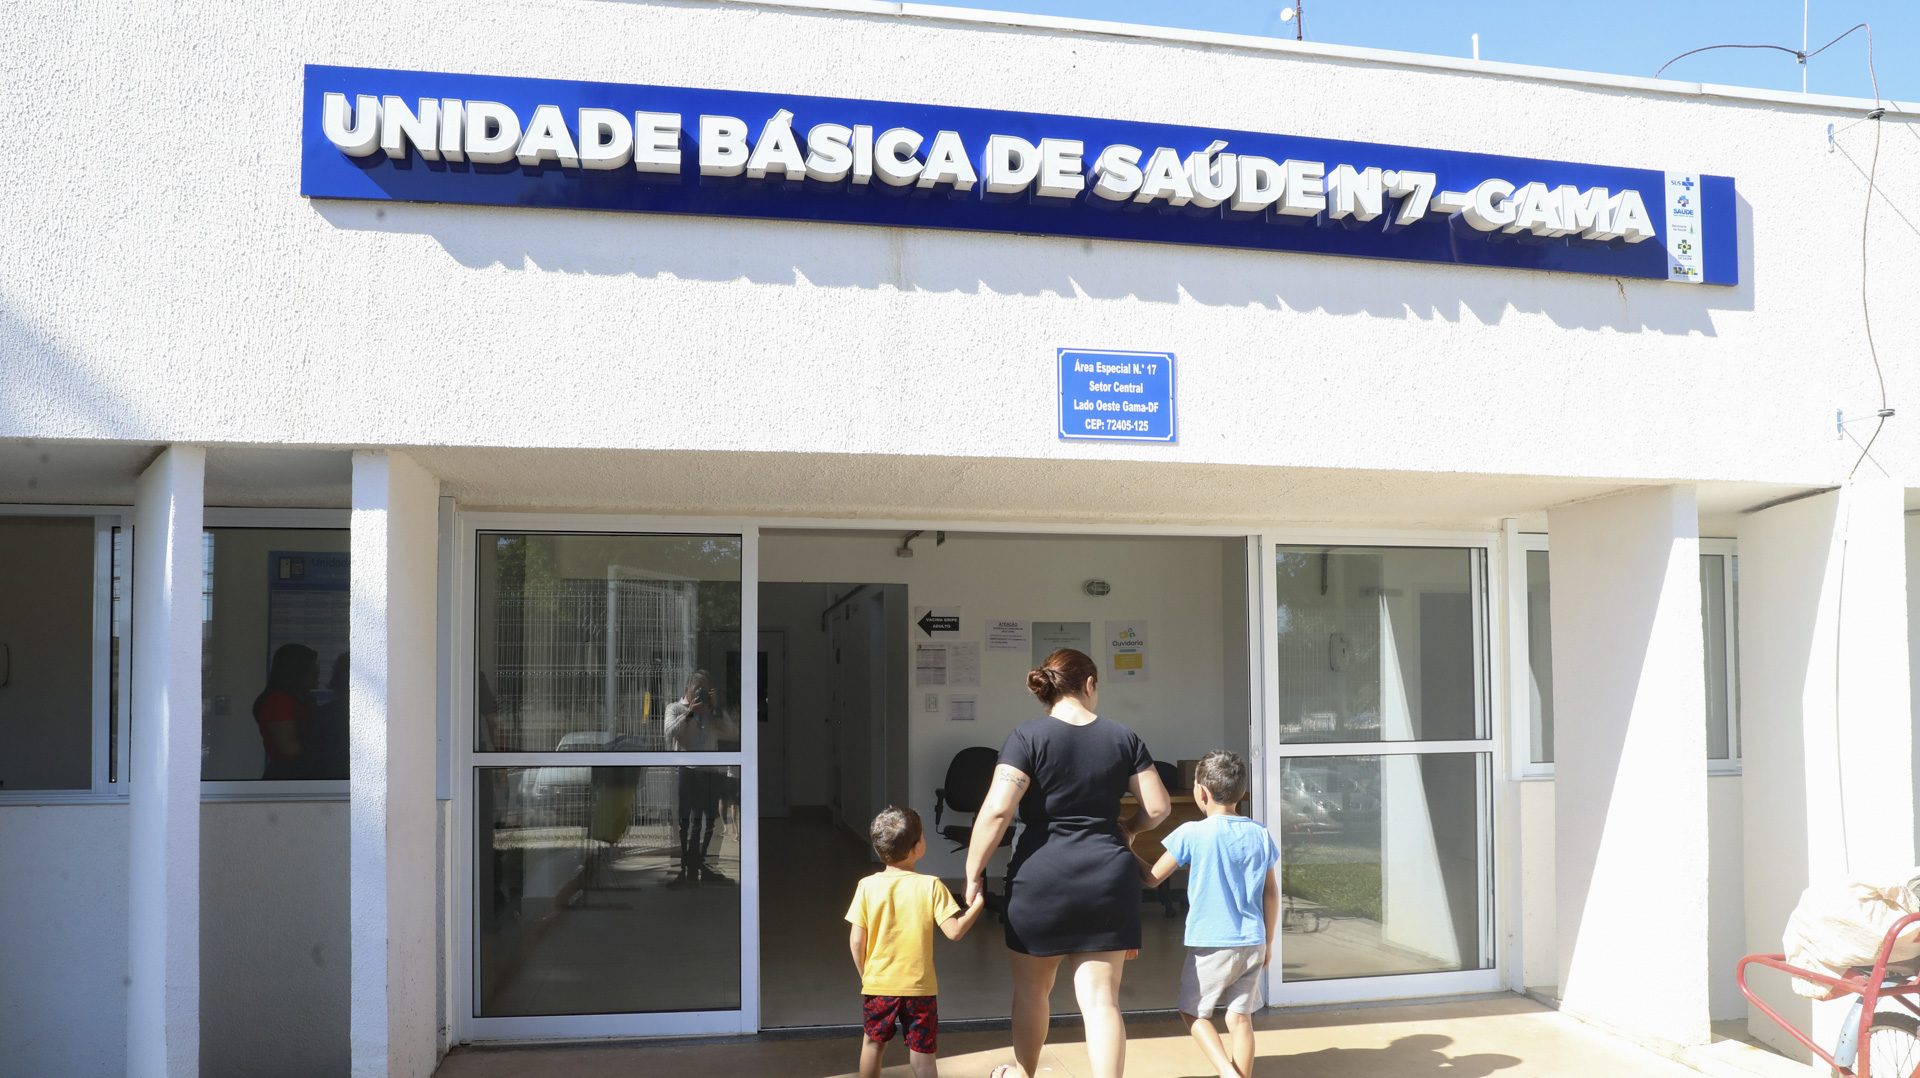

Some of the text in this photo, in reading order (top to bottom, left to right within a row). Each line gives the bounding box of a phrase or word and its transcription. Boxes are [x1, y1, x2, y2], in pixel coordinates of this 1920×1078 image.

[323, 91, 682, 174] UNIDADE
[699, 109, 977, 191] BÁSICA
[983, 133, 1084, 198] DE
[1092, 140, 1325, 218] SAÚDE
[1450, 177, 1656, 244] GAMA
[1074, 358, 1094, 373] Área
[1096, 361, 1131, 376] Especial
[1147, 364, 1157, 376] 17
[1089, 380, 1144, 393] Setor Central
[1073, 399, 1159, 413] Lado Oeste Gama-DF
[1085, 418, 1149, 432] CEP: 72405-125
